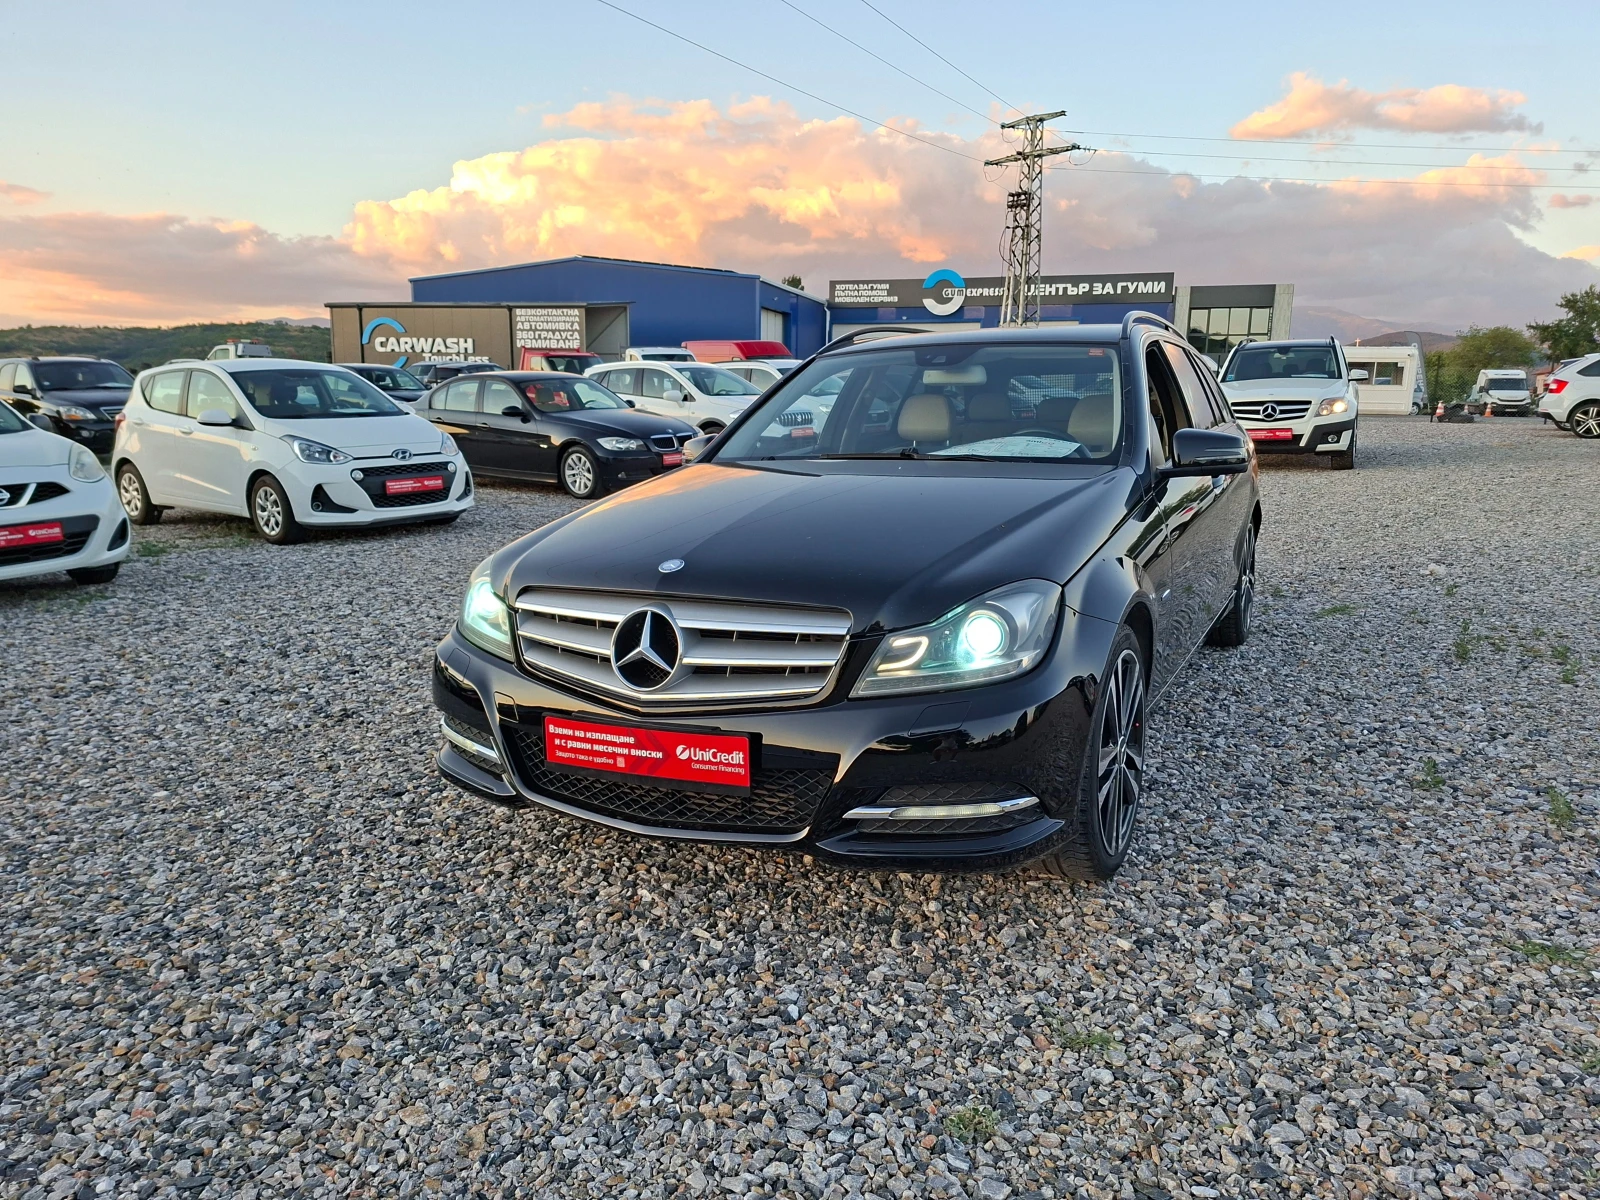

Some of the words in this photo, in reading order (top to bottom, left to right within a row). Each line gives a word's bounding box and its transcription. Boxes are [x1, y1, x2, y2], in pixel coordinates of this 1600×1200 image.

[966, 288, 1005, 297] EXPRESS
[1092, 282, 1115, 295] ЗА
[1116, 281, 1166, 294] ГУМИ
[516, 308, 580, 316] БЕЗКОНТАКТНА
[516, 322, 580, 330] АВТОМИВКА
[516, 331, 534, 339] 360
[535, 331, 580, 340] ГРАДУСА
[374, 336, 474, 354] CARWASH
[516, 339, 581, 349] ИЗМИВАНЕ
[549, 724, 573, 735] Вземи
[574, 730, 585, 738] на
[586, 731, 635, 744] изплащане
[567, 740, 592, 750] равни
[592, 743, 629, 755] месечни
[630, 749, 663, 758] вноски
[555, 749, 575, 759] Защото
[576, 752, 588, 761] така
[593, 756, 614, 764] удобно
[690, 747, 745, 765] UniCredit
[691, 762, 718, 771] Consumer
[718, 764, 745, 775] Financing
